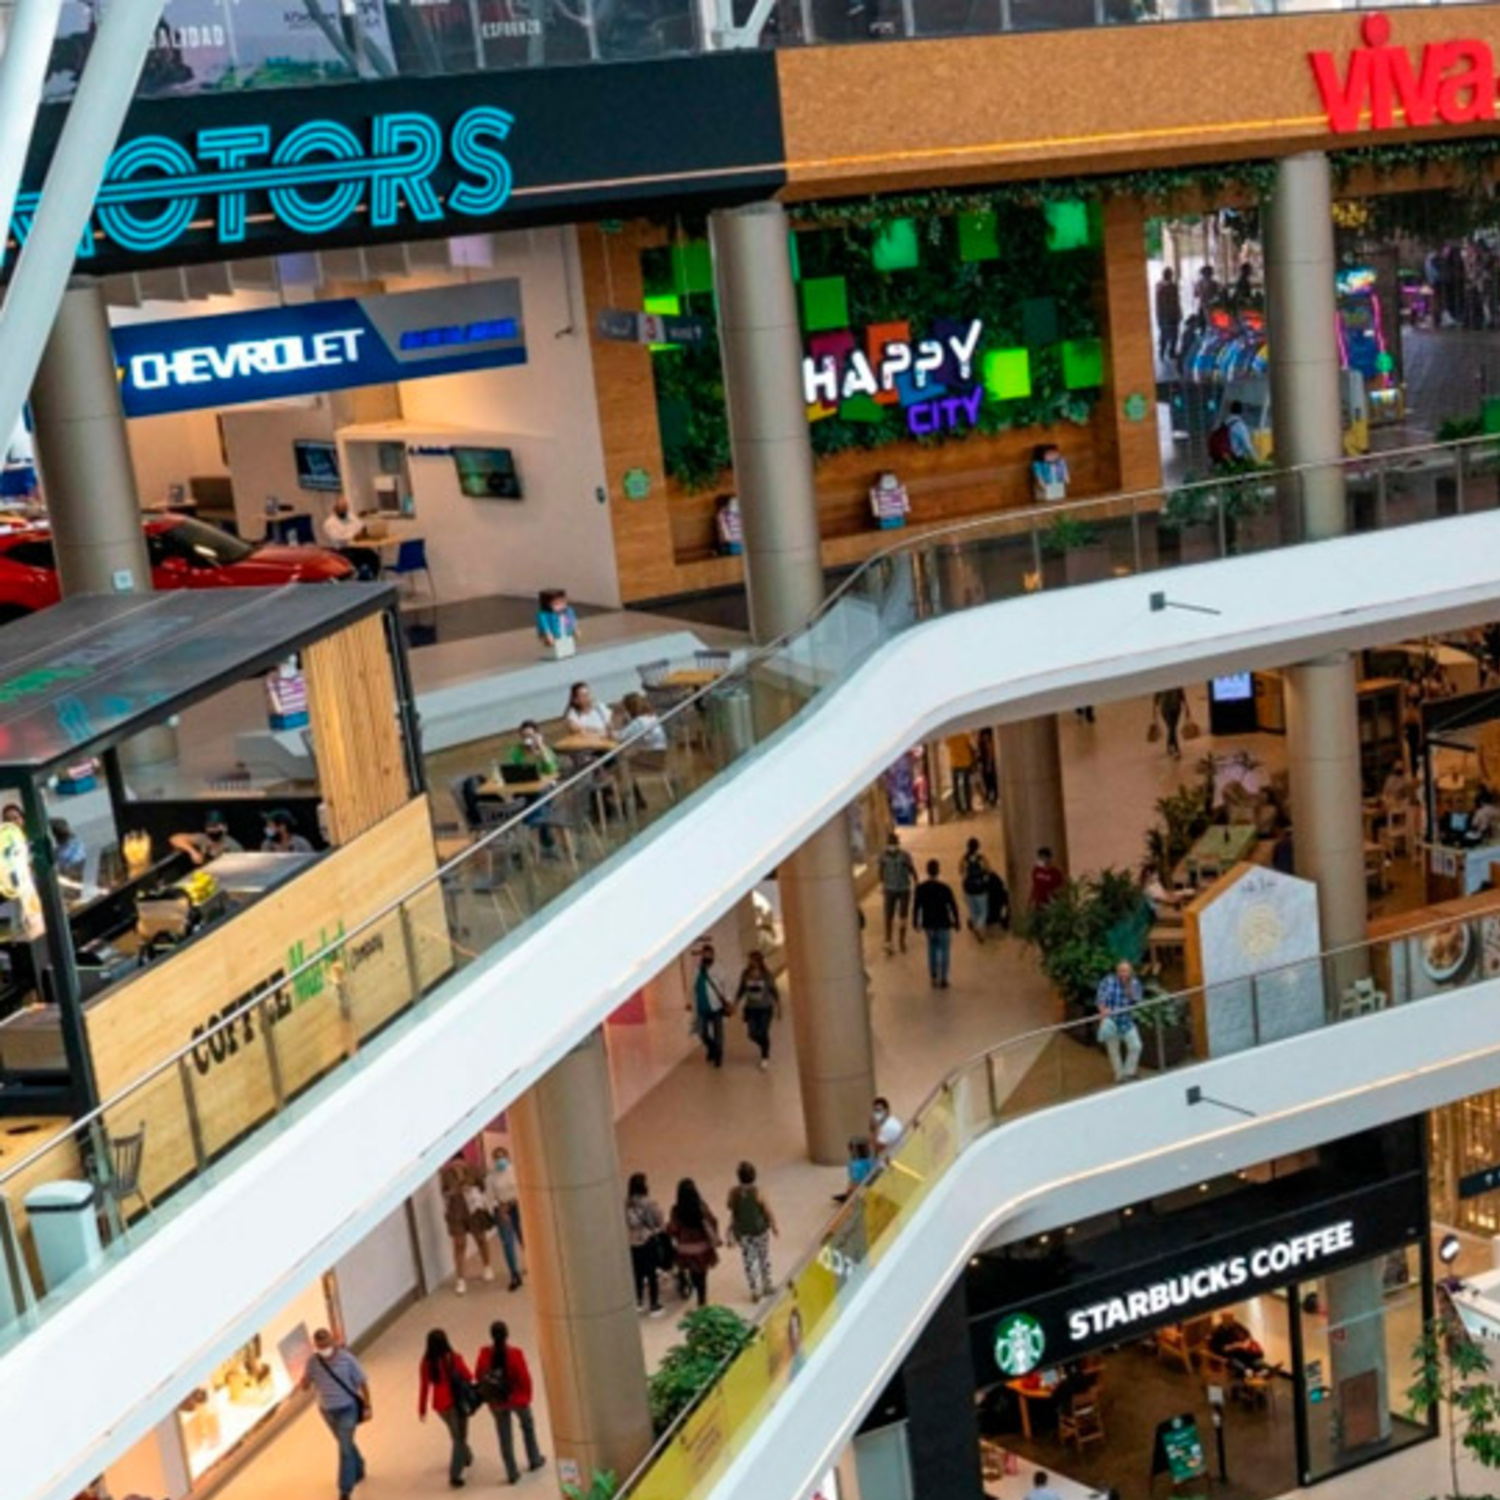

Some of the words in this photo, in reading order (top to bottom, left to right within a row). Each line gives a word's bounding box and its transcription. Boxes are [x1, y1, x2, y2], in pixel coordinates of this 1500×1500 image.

[131, 328, 364, 391] CHEVROLET
[802, 319, 982, 404] HAPPY
[908, 385, 983, 434] CITY
[1069, 1257, 1248, 1341] STARBUCKS
[1250, 1220, 1354, 1278] COFFEE
